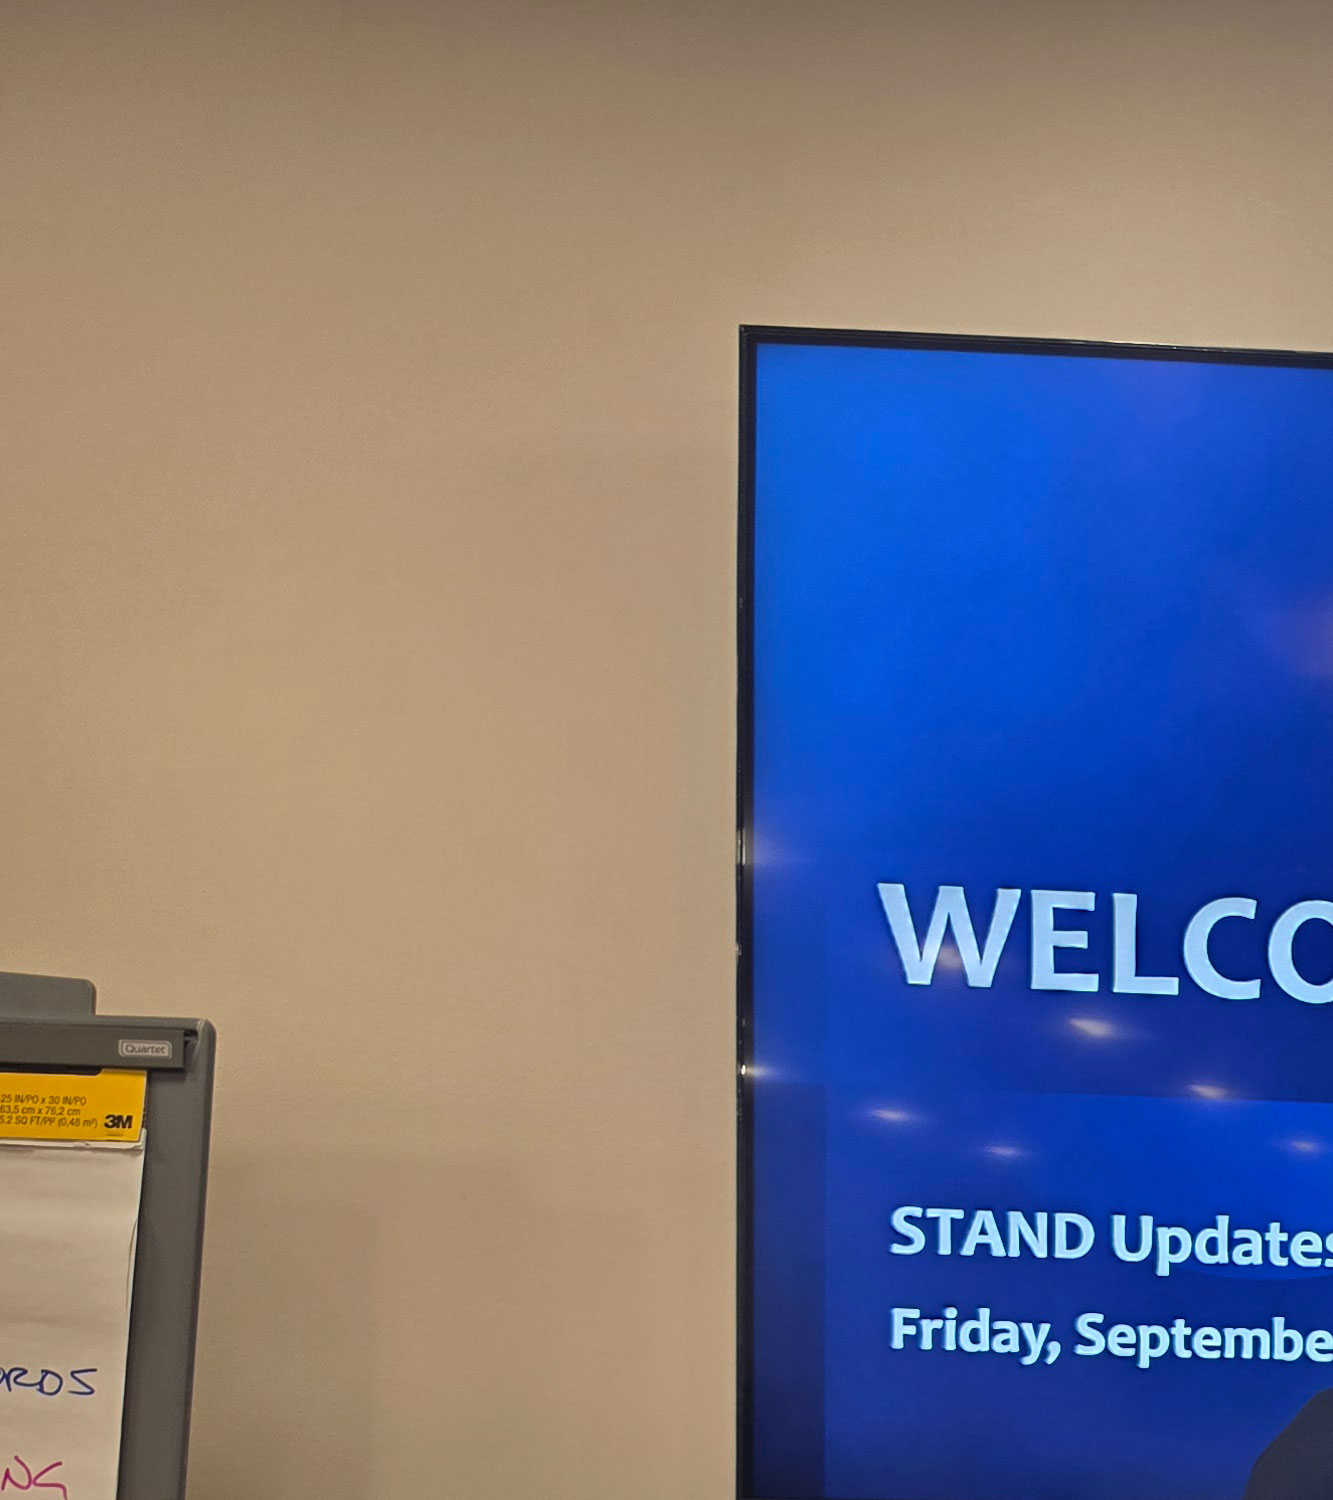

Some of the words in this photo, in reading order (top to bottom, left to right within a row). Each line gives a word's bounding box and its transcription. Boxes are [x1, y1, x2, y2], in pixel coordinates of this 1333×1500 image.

[67, 1108, 82, 1116] cm
[104, 1114, 133, 1129] 3M
[889, 1205, 1095, 1260] STAND
[889, 1306, 1063, 1367] Friday,
